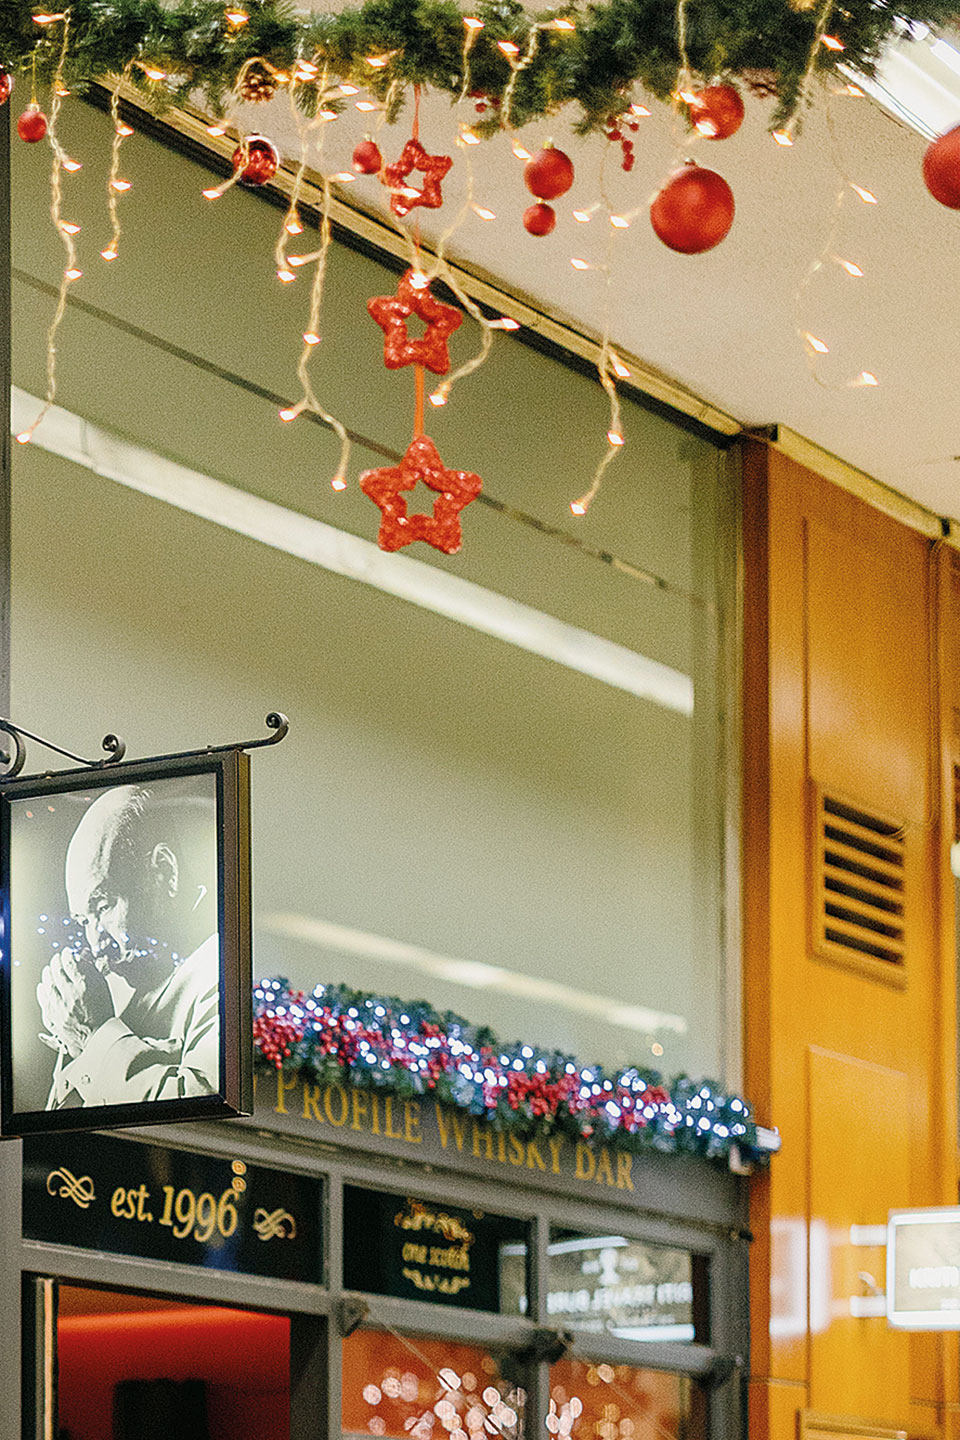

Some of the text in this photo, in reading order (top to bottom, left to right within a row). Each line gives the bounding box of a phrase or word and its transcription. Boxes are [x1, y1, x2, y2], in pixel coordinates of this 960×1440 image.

[275, 1069, 635, 1191] PROFILE WHISKY BAR
[111, 1184, 240, 1243] est. 1996
